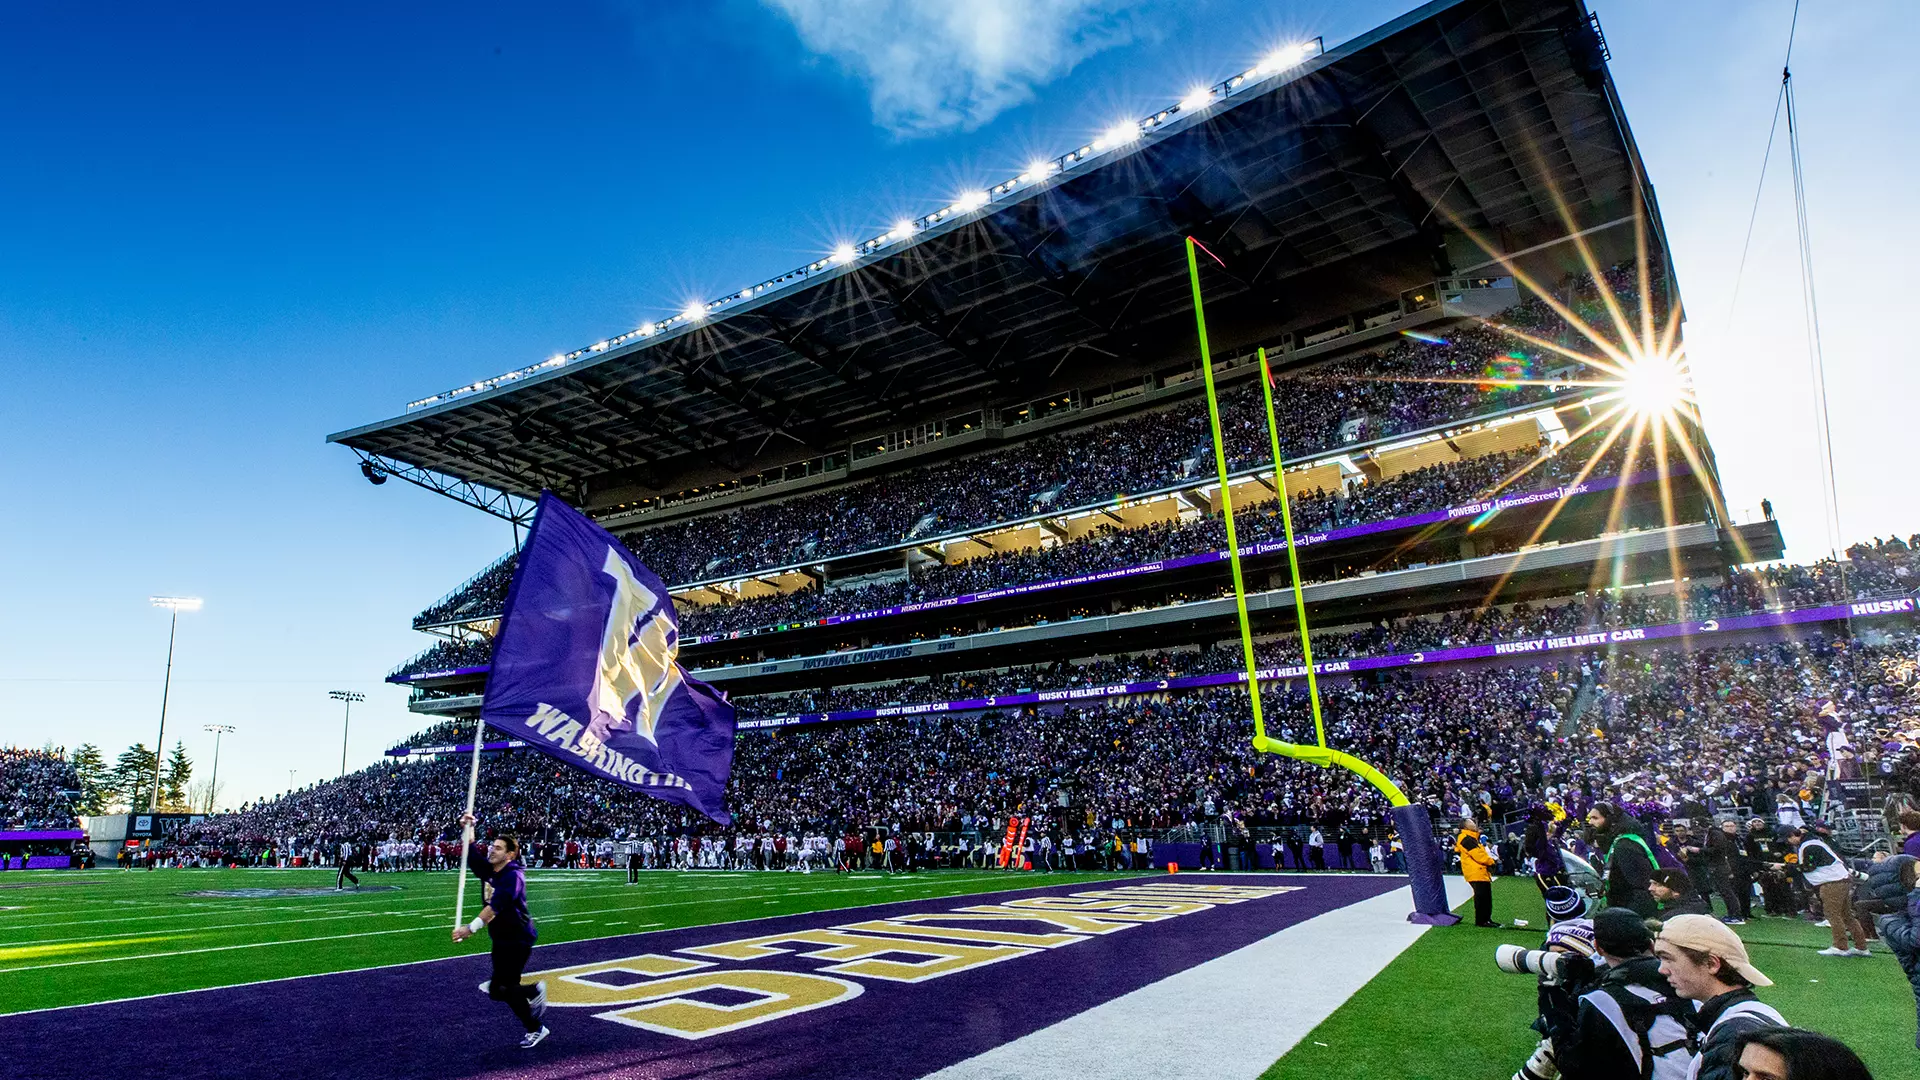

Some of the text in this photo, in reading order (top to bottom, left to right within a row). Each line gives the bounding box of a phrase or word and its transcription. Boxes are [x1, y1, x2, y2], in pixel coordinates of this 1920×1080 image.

[1448, 503, 1482, 518] POWERED
[1482, 502, 1492, 511] BY
[1564, 484, 1588, 496] Bank
[1246, 546, 1254, 554] BY
[1309, 533, 1328, 543] Bank
[977, 590, 1006, 599] WELCOME
[1028, 581, 1060, 591] GREATEST
[1097, 570, 1126, 580] COLLEGE
[1127, 564, 1161, 574] FOOTBALL
[901, 598, 958, 613] HUSKY ATHLETICS
[1851, 598, 1913, 615] HUSK
[855, 611, 878, 619] NEXT
[1495, 628, 1645, 654] HUSKY HELMET CAR
[1324, 662, 1350, 672] CAR
[1039, 685, 1127, 701] HUSKY HELMET CAR
[876, 702, 949, 717] HUSKY HELMET CAR
[738, 716, 800, 729] HUSKY HELMET CAR
